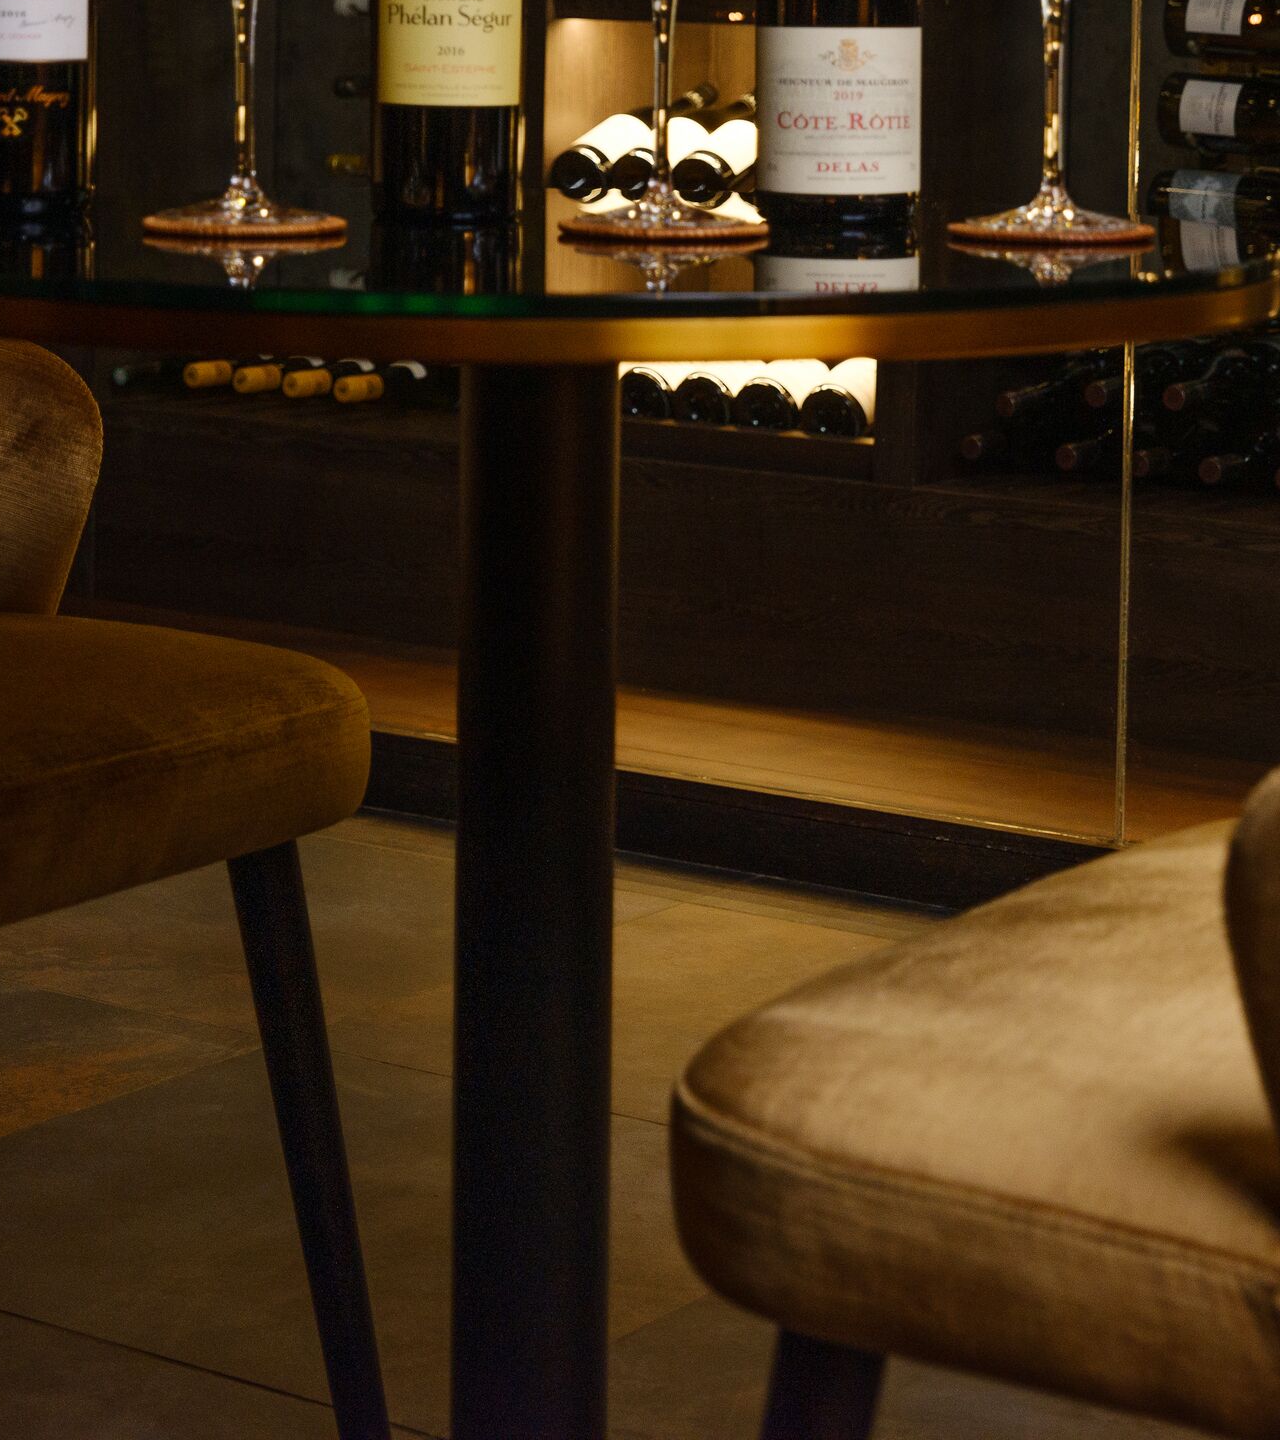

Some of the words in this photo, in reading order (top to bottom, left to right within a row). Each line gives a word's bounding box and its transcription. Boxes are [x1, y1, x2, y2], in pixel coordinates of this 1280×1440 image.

[387, 2, 452, 26] Phélan
[457, 4, 513, 34] Ségur
[437, 46, 465, 57] 2016
[833, 91, 864, 101] 2019
[816, 161, 880, 173] DELAS
